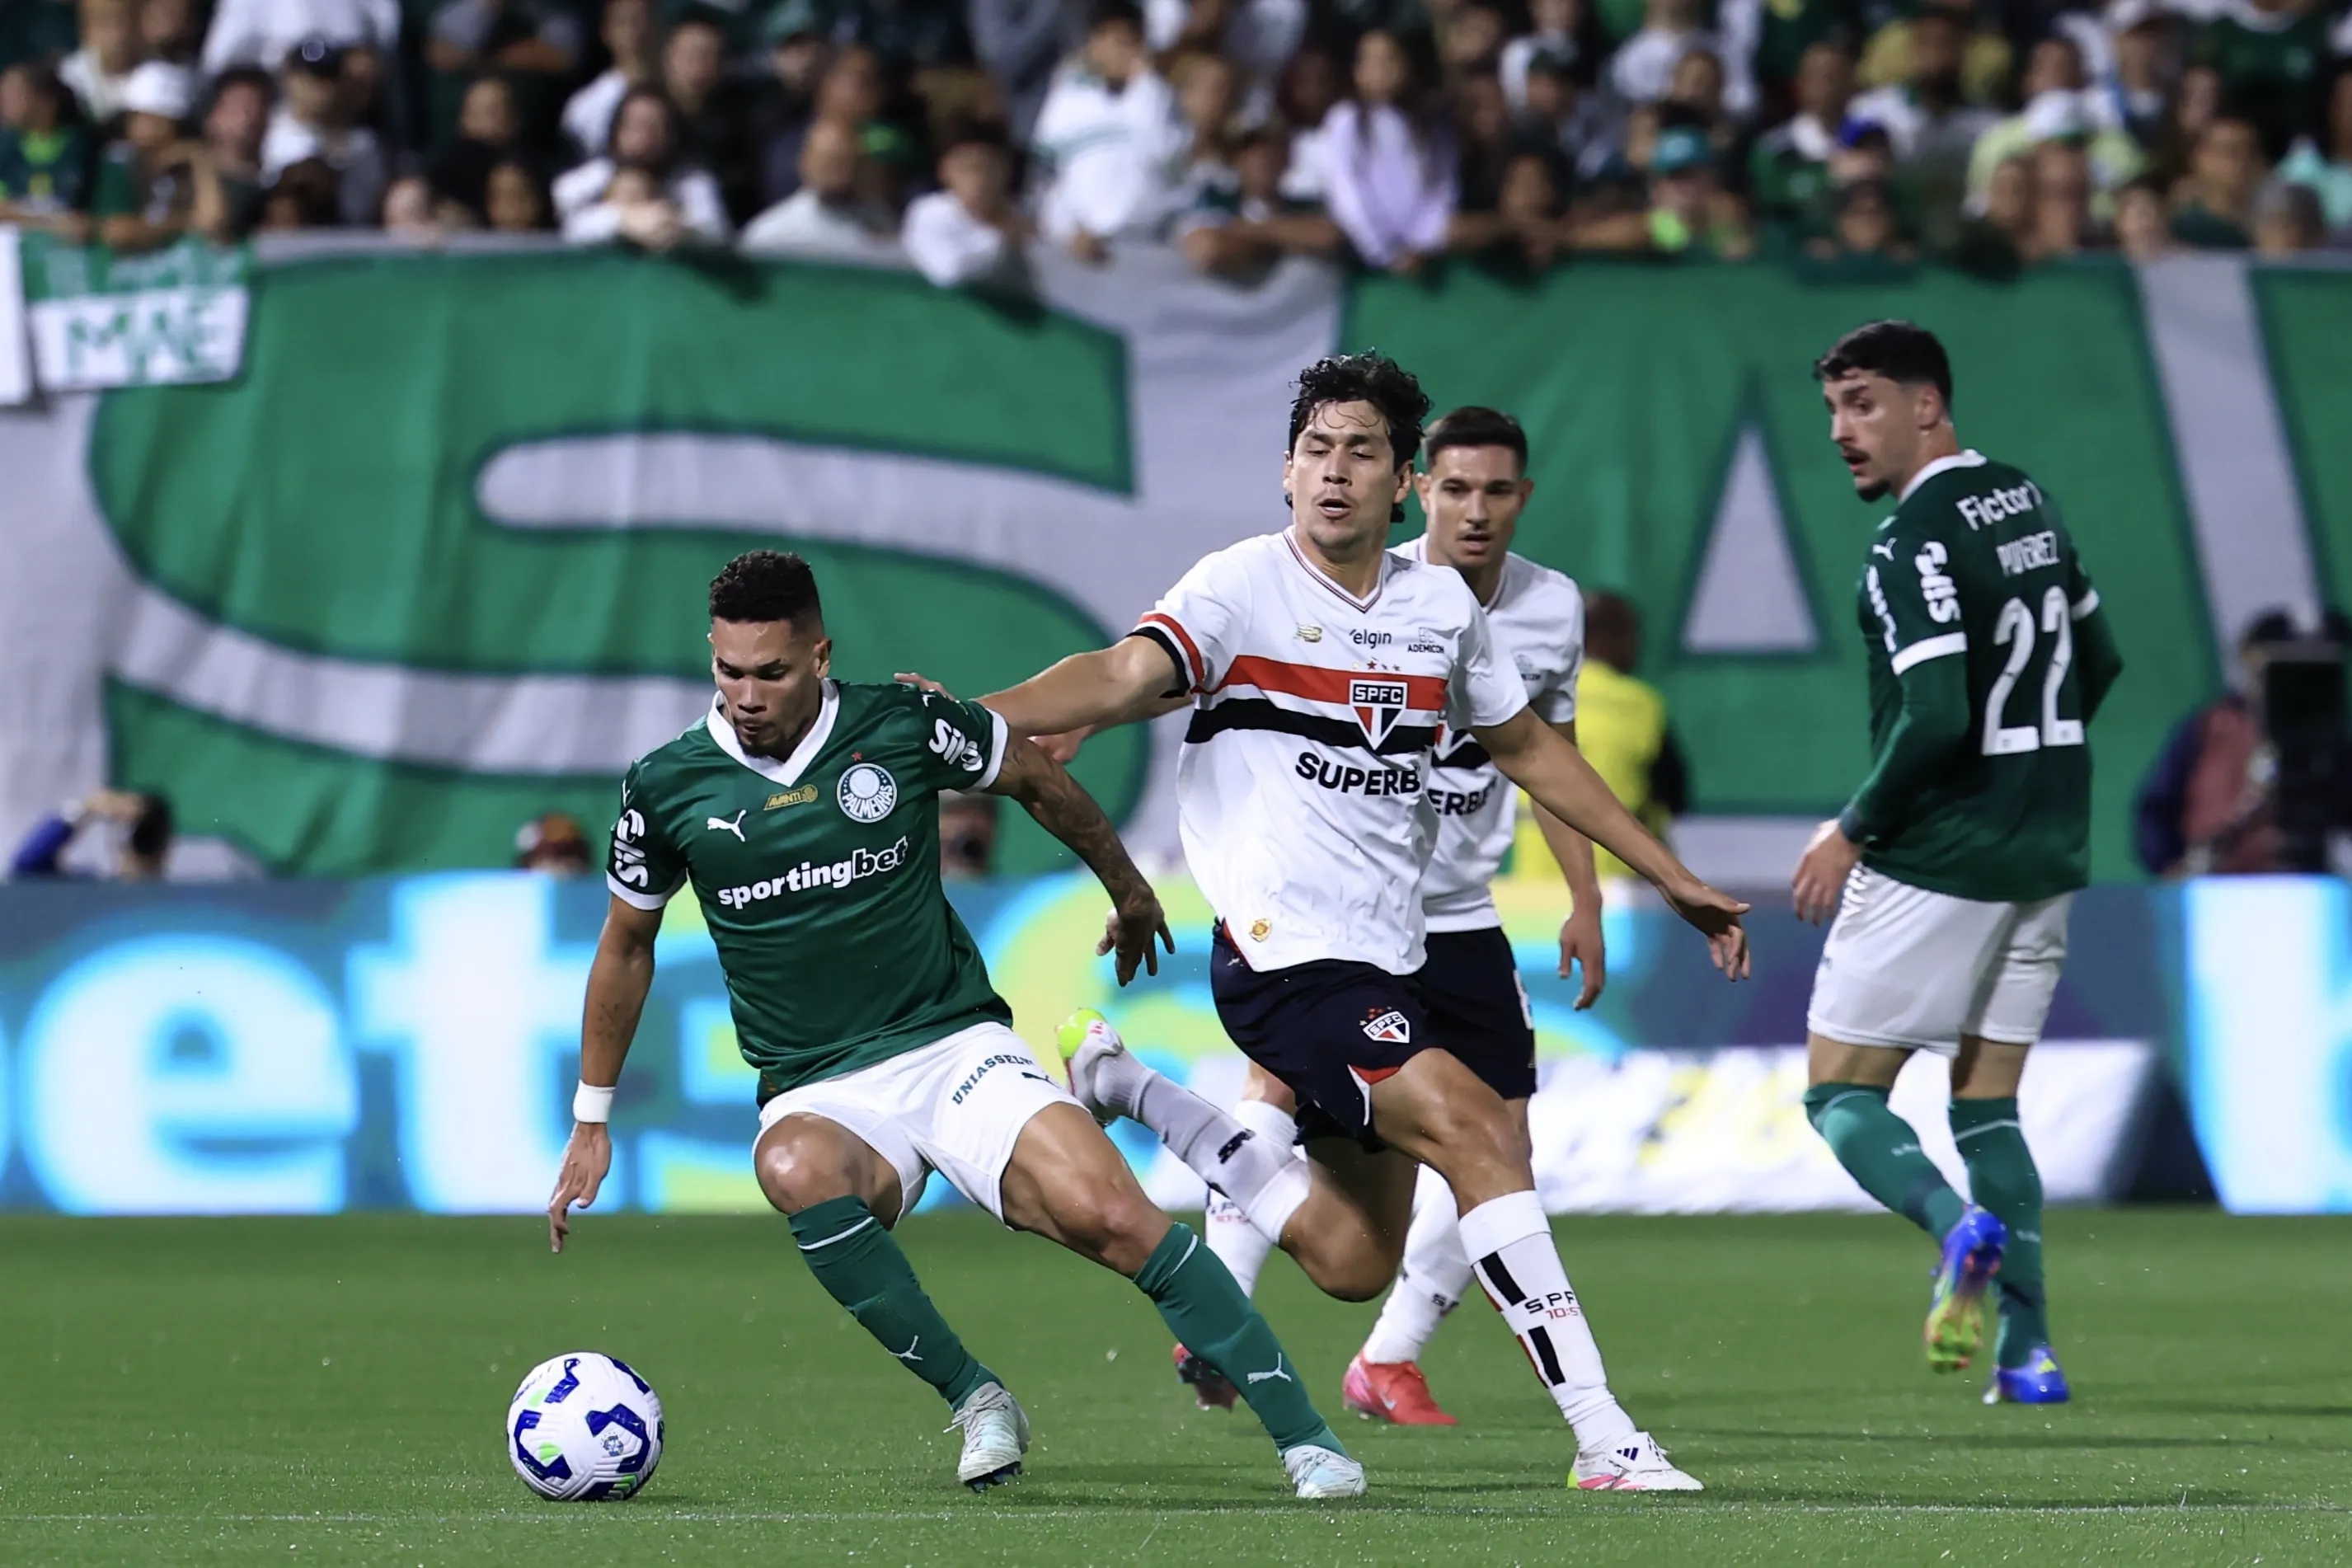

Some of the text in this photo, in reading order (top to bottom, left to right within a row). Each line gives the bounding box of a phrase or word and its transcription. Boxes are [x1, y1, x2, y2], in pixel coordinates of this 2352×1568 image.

[1350, 628, 1392, 650] elgin
[1982, 585, 2085, 756] 22
[1354, 687, 1402, 703] SPFC
[768, 791, 801, 807] AVANTI
[842, 785, 893, 819] PALMEIRAS
[717, 835, 908, 910] sportingbet
[1369, 1014, 1403, 1035] SPFC
